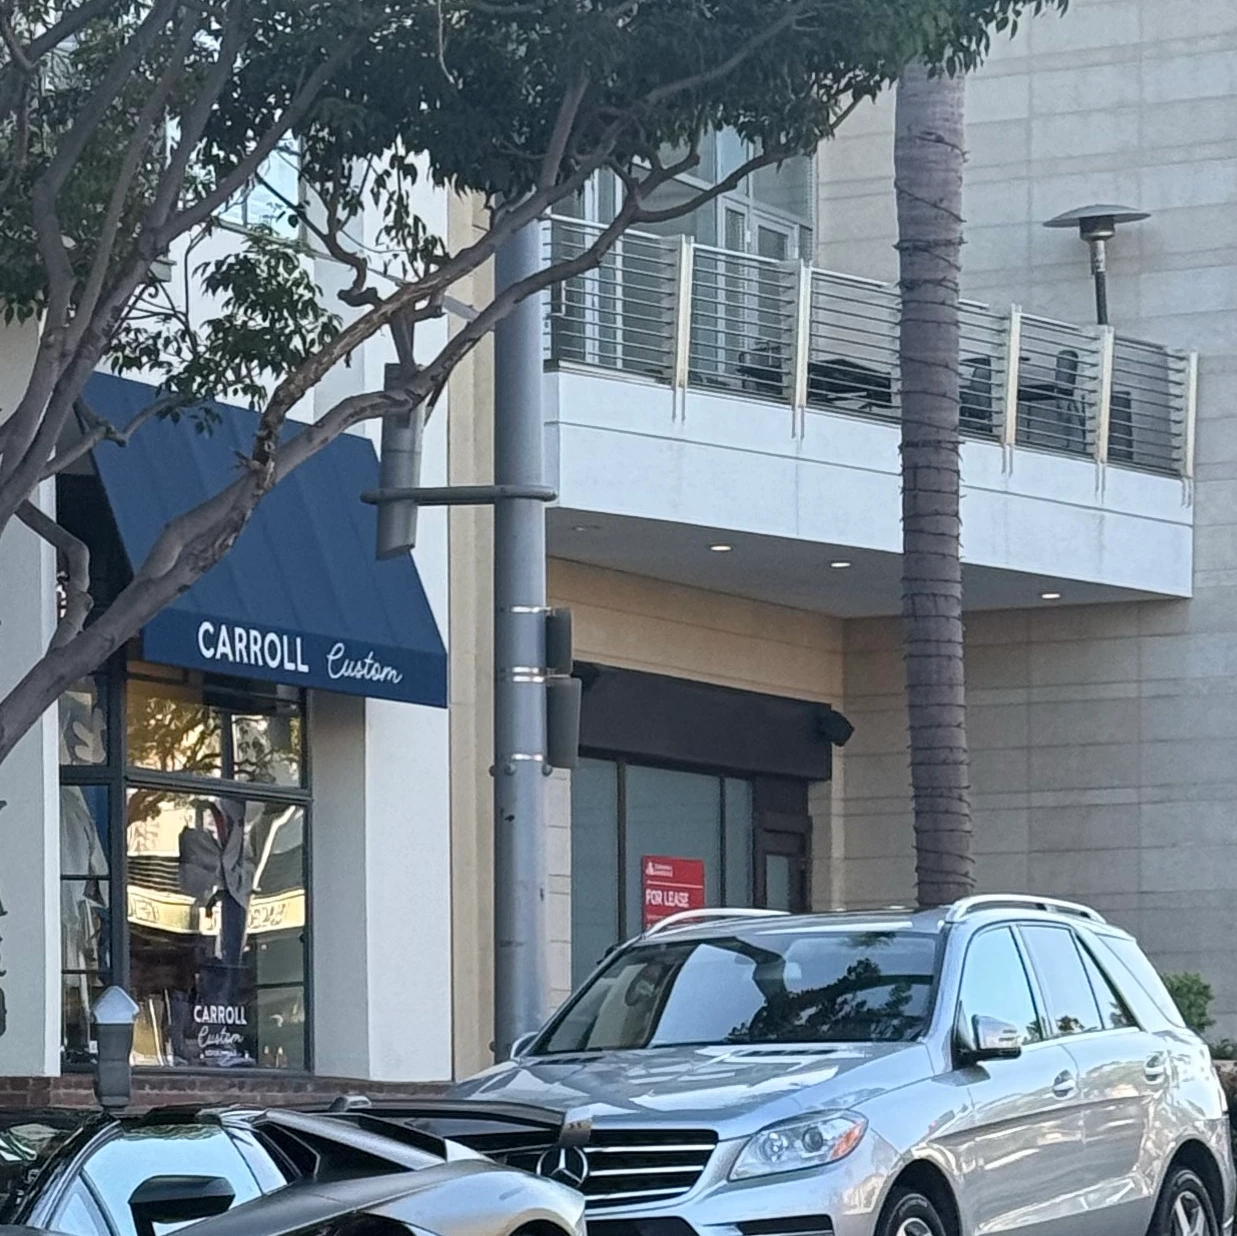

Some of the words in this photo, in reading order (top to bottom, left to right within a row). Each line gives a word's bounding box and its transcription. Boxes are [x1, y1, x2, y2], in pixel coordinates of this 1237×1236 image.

[198, 621, 309, 673] CARROLL
[326, 643, 403, 684] Custom
[645, 889, 663, 906] FOR
[664, 891, 689, 908] LEASE
[193, 1005, 248, 1025] CARROLL
[197, 1025, 244, 1048] Custom
